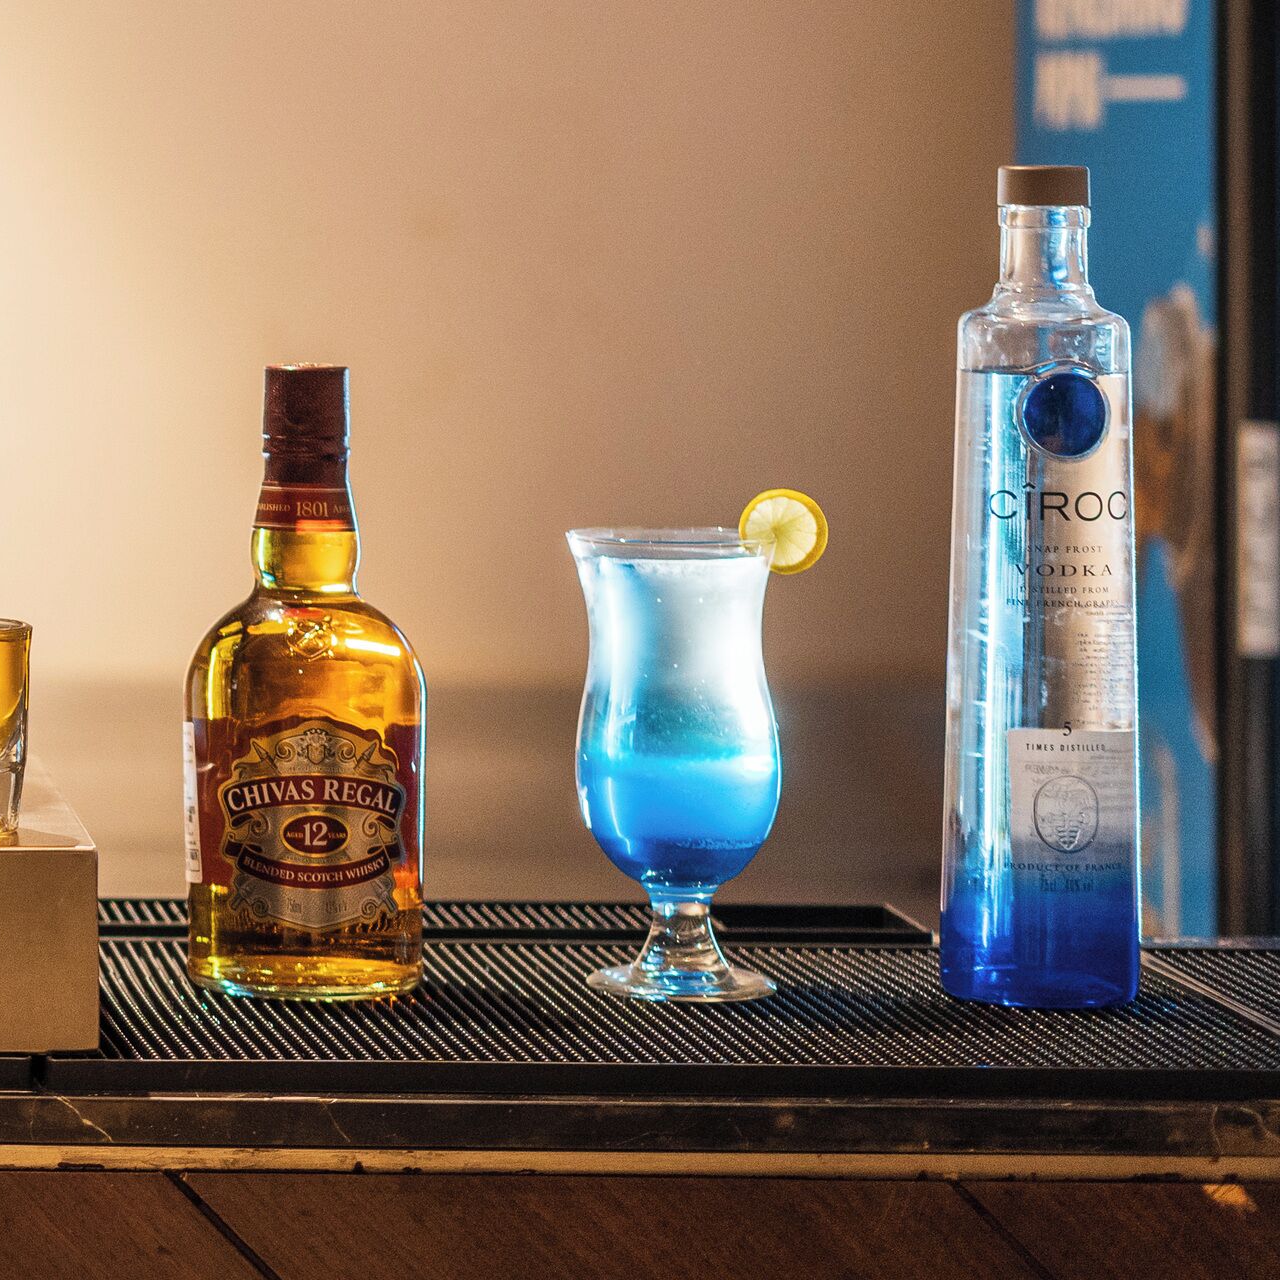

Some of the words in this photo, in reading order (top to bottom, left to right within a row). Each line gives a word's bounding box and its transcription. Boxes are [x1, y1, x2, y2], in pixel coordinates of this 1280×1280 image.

[296, 501, 329, 518] 1801
[989, 482, 1127, 521] CÎROC
[1027, 545, 1059, 554] SNAP
[1066, 545, 1103, 554] FROST
[1015, 564, 1112, 577] VODKA
[1082, 586, 1109, 594] FROM
[1062, 721, 1072, 737] 5
[1026, 743, 1055, 751] TIMES
[1060, 743, 1107, 752] DISTILLED
[227, 779, 316, 811] CHIVAS
[323, 778, 396, 814] REGAL
[303, 821, 328, 846] 12
[243, 856, 295, 881] BLENDED
[297, 870, 344, 883] SCOTCH
[345, 857, 386, 880] WHISKY
[1004, 862, 1063, 871] PRODUCT
[1065, 862, 1080, 871] OF
[1085, 861, 1124, 871] FRANCE
